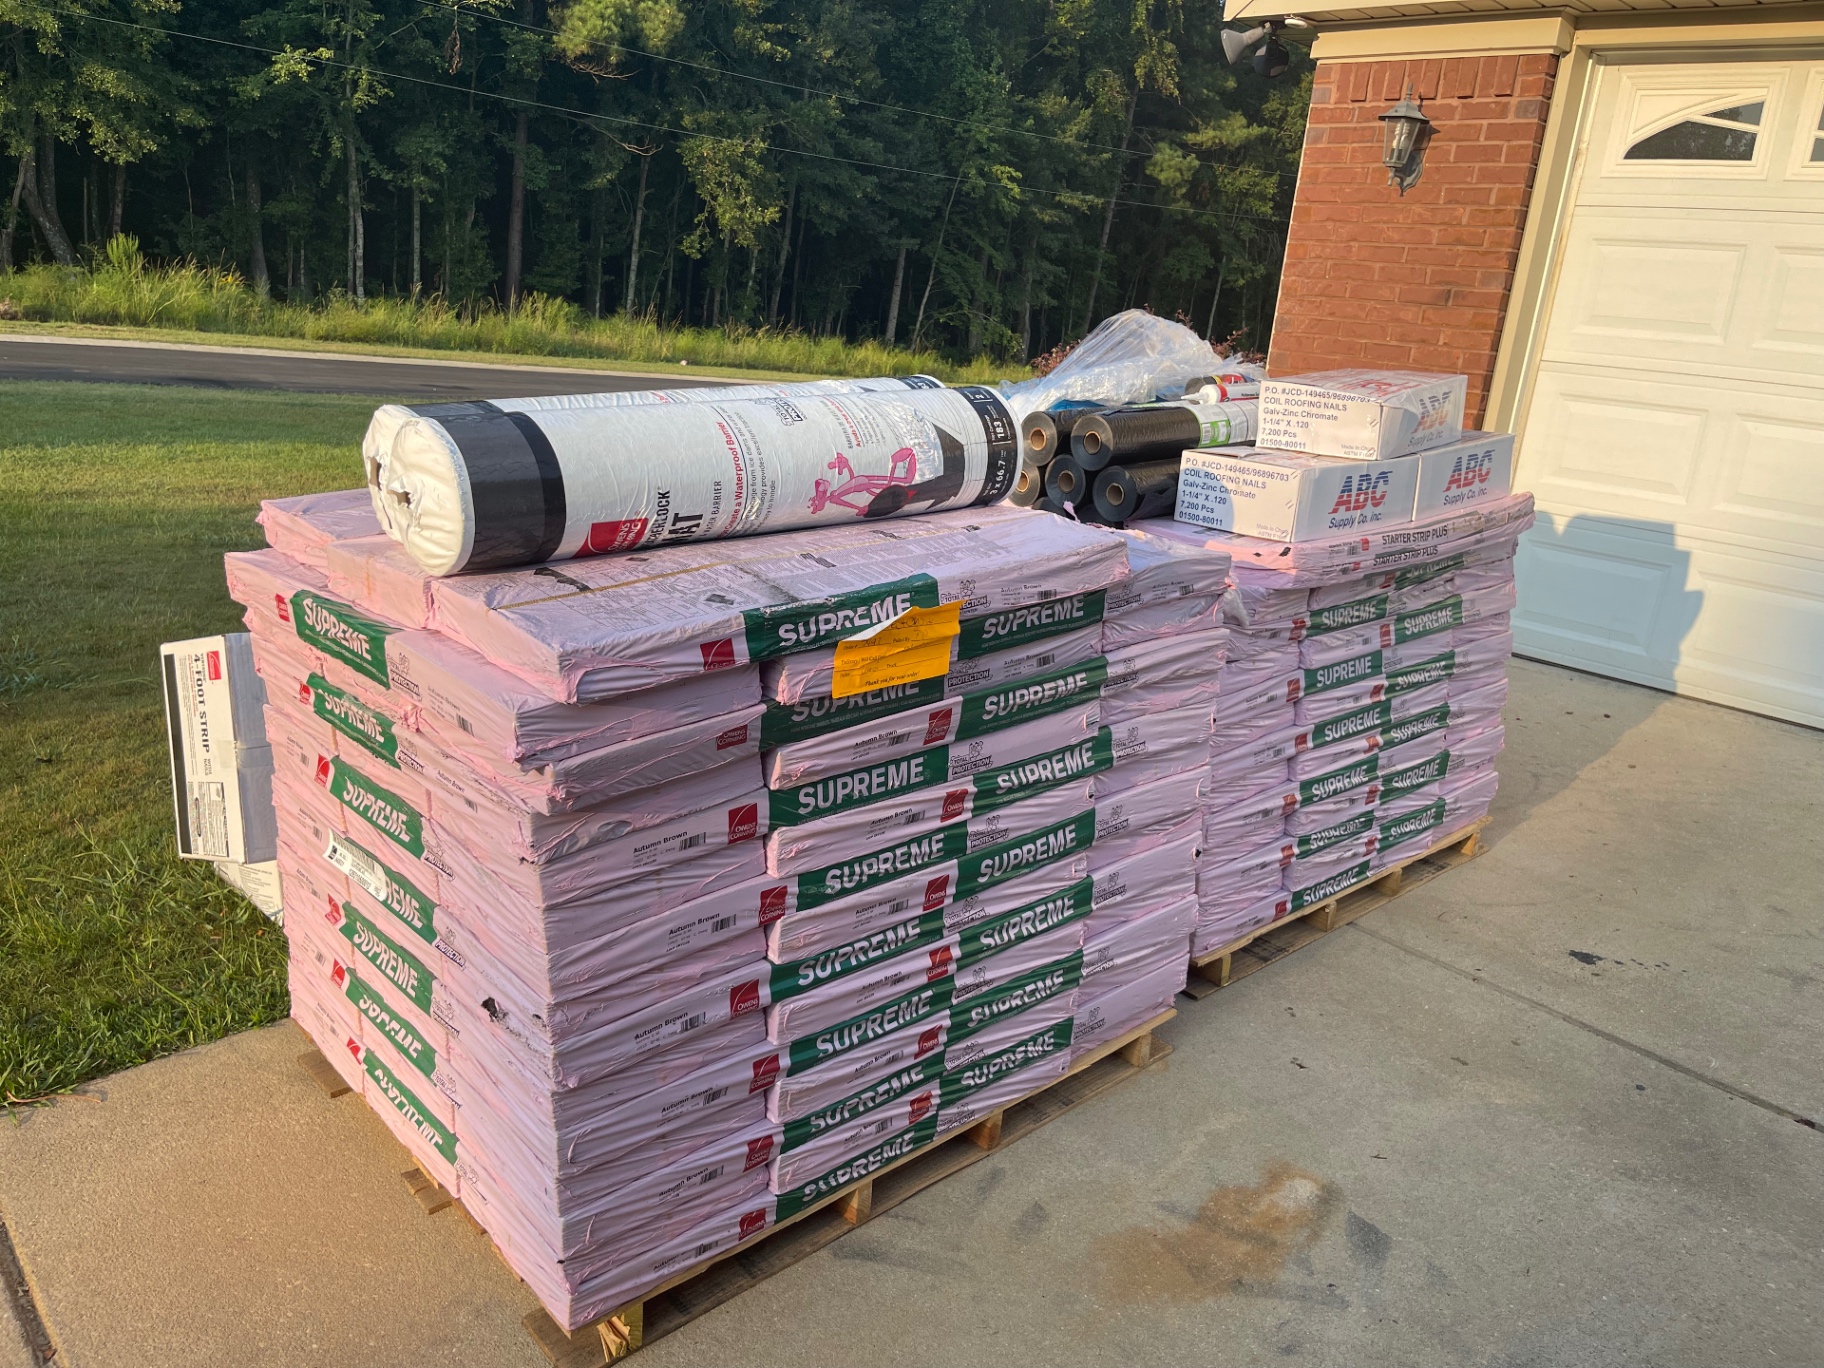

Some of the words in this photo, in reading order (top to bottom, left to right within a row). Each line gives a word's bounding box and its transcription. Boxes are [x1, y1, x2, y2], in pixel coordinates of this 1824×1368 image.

[1264, 386, 1280, 394] P.O.
[1263, 408, 1299, 418] Galv-Zinc
[1300, 410, 1338, 422] Chromate
[1264, 397, 1282, 406] COIL
[1284, 398, 1322, 409] ROOFING
[1324, 401, 1347, 412] NAILS
[1411, 390, 1452, 434] ABC
[716, 421, 734, 446] Barrier
[994, 421, 1004, 439] 183
[1262, 428, 1282, 437] 7,200
[1282, 430, 1298, 438] Pcs
[1293, 420, 1309, 428] .120
[1260, 438, 1306, 450] 01500-80011
[1408, 432, 1427, 446] Supply
[728, 446, 744, 500] Waterproof
[758, 456, 768, 487] provides
[996, 460, 1006, 482] 66.7
[1184, 468, 1202, 478] COIL
[1204, 471, 1240, 484] ROOFING
[1242, 477, 1267, 490] NAILS
[1185, 458, 1200, 466] P.O.
[1202, 460, 1289, 482] #JCD-149465/96896703
[1442, 448, 1496, 492] ABC
[711, 480, 722, 515] BARRIER
[1183, 480, 1218, 492] Galv-Zinc
[1220, 485, 1256, 500] Chromate
[1328, 470, 1394, 514] ABC
[1443, 492, 1466, 506] Supply
[1467, 490, 1476, 500] Co.
[1178, 511, 1222, 526] 01500-80011
[1180, 500, 1200, 511] 7,200
[1201, 505, 1214, 514] Pcs
[1328, 515, 1356, 530] Supply
[1358, 513, 1368, 524] Co.
[1382, 532, 1411, 546] STARTER
[1412, 530, 1430, 542] STRIP
[1431, 525, 1448, 540] PLUS
[1373, 553, 1402, 566] STARTER
[1403, 550, 1422, 563] STRIP
[1422, 546, 1438, 558] PLUS
[779, 592, 912, 648] SUPREME
[981, 597, 1084, 639] SUPREME
[1322, 600, 1376, 628] SUPREME
[1404, 607, 1453, 635] SUPREME
[302, 598, 372, 661] SUPREME
[194, 654, 206, 706] 4-FOOT
[948, 670, 990, 686] PROTECTION
[1316, 656, 1372, 688] SUPREME
[982, 671, 1088, 720] SUPREME
[199, 712, 210, 754] STRIP
[723, 728, 746, 739] OWENS
[1324, 708, 1381, 742] SUPREME
[1391, 712, 1441, 742] SUPREME
[718, 735, 747, 746] CORNING
[854, 736, 878, 748] Autumn
[879, 730, 898, 740] Brown
[952, 758, 990, 774] PROTECTION
[954, 756, 967, 765] TOTAL
[996, 742, 1095, 794] SUPREME
[798, 756, 925, 814] SUPREME
[1312, 764, 1368, 801] SUPREME
[1392, 759, 1440, 789] SUPREME
[451, 780, 466, 793] Brown
[343, 776, 411, 843] SUPREME
[870, 814, 893, 826] Autumn
[894, 808, 912, 819] Brown
[634, 840, 662, 854] Autumn
[664, 831, 688, 844] Brown
[971, 831, 1008, 848] PROTECTION
[825, 833, 945, 894] SUPREME
[977, 823, 1076, 883] SUPREME
[930, 890, 946, 900] OWENS
[1302, 868, 1360, 906] SUPREME
[386, 874, 423, 929] REME
[668, 922, 696, 936] Autumn
[698, 913, 720, 925] Brown
[760, 908, 785, 921] CORNING
[980, 895, 1074, 950] SUPREME
[353, 922, 420, 998] SUPREME
[436, 941, 466, 965] PROTECTION
[798, 918, 922, 986] SUPREME
[738, 998, 758, 1010] OWENS
[634, 1024, 662, 1040] Autumn
[664, 1012, 688, 1026] Brown
[816, 990, 934, 1058] SUPREME
[960, 1030, 1055, 1087] SUPREME
[751, 1076, 776, 1089] CORNING
[662, 1097, 690, 1113] Autumn
[810, 1066, 925, 1134] SUPREME
[659, 1180, 685, 1196] Autumn
[686, 1168, 709, 1182] Brown
